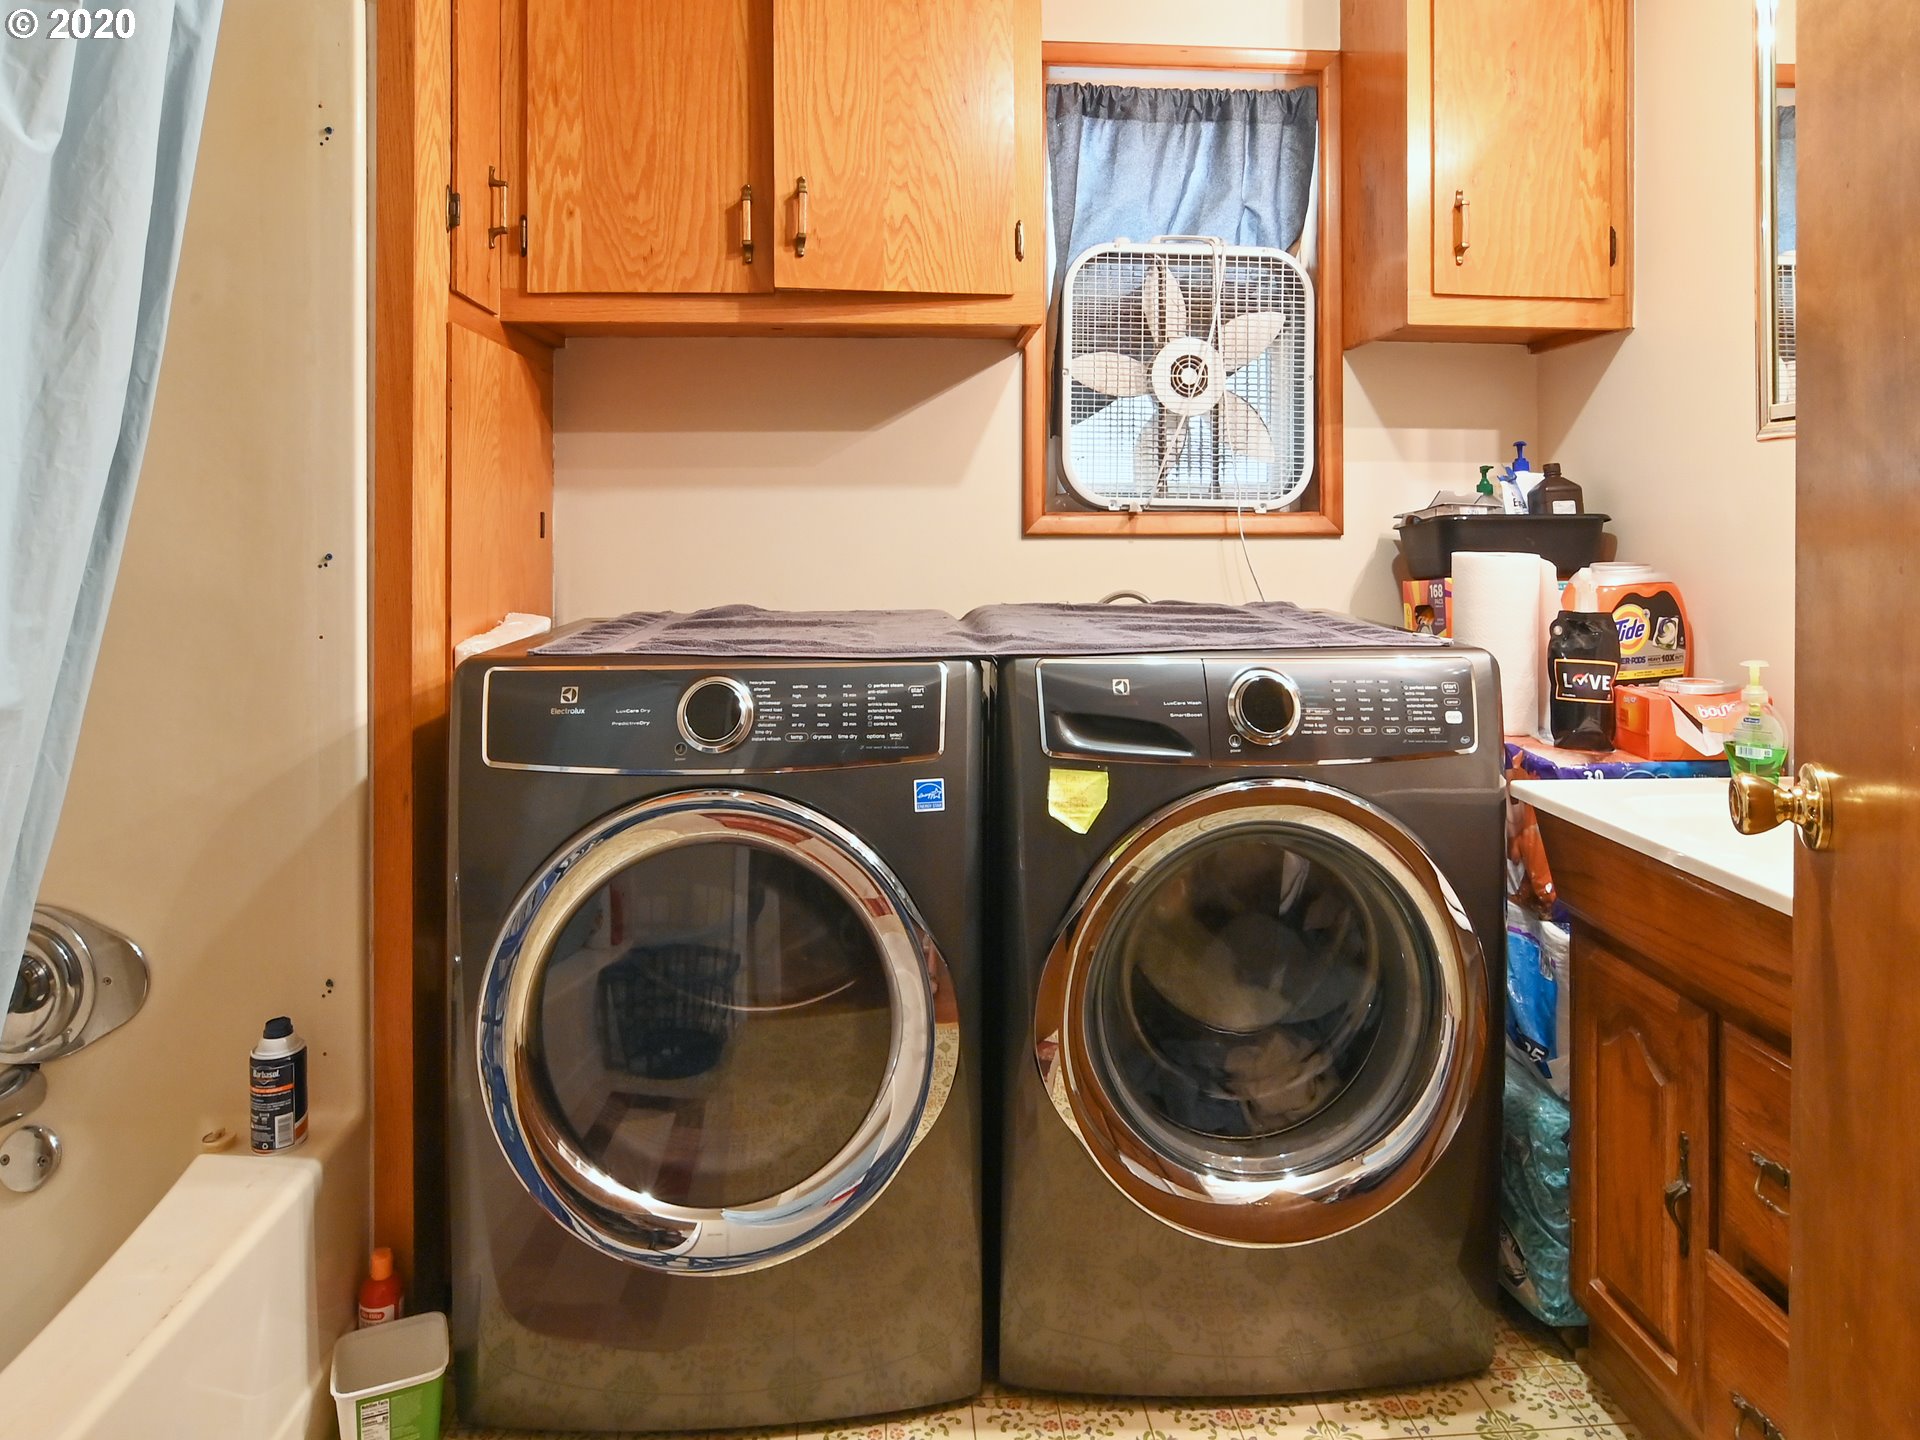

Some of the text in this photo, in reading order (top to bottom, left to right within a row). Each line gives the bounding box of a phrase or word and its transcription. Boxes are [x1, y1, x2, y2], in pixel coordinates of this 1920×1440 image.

[1429, 584, 1444, 598] 168
[1616, 618, 1645, 641] Tide
[1662, 654, 1674, 662] 10X
[1562, 673, 1611, 690] LOVE
[550, 707, 585, 715] Electrolux
[253, 1070, 280, 1078] Barbasol
